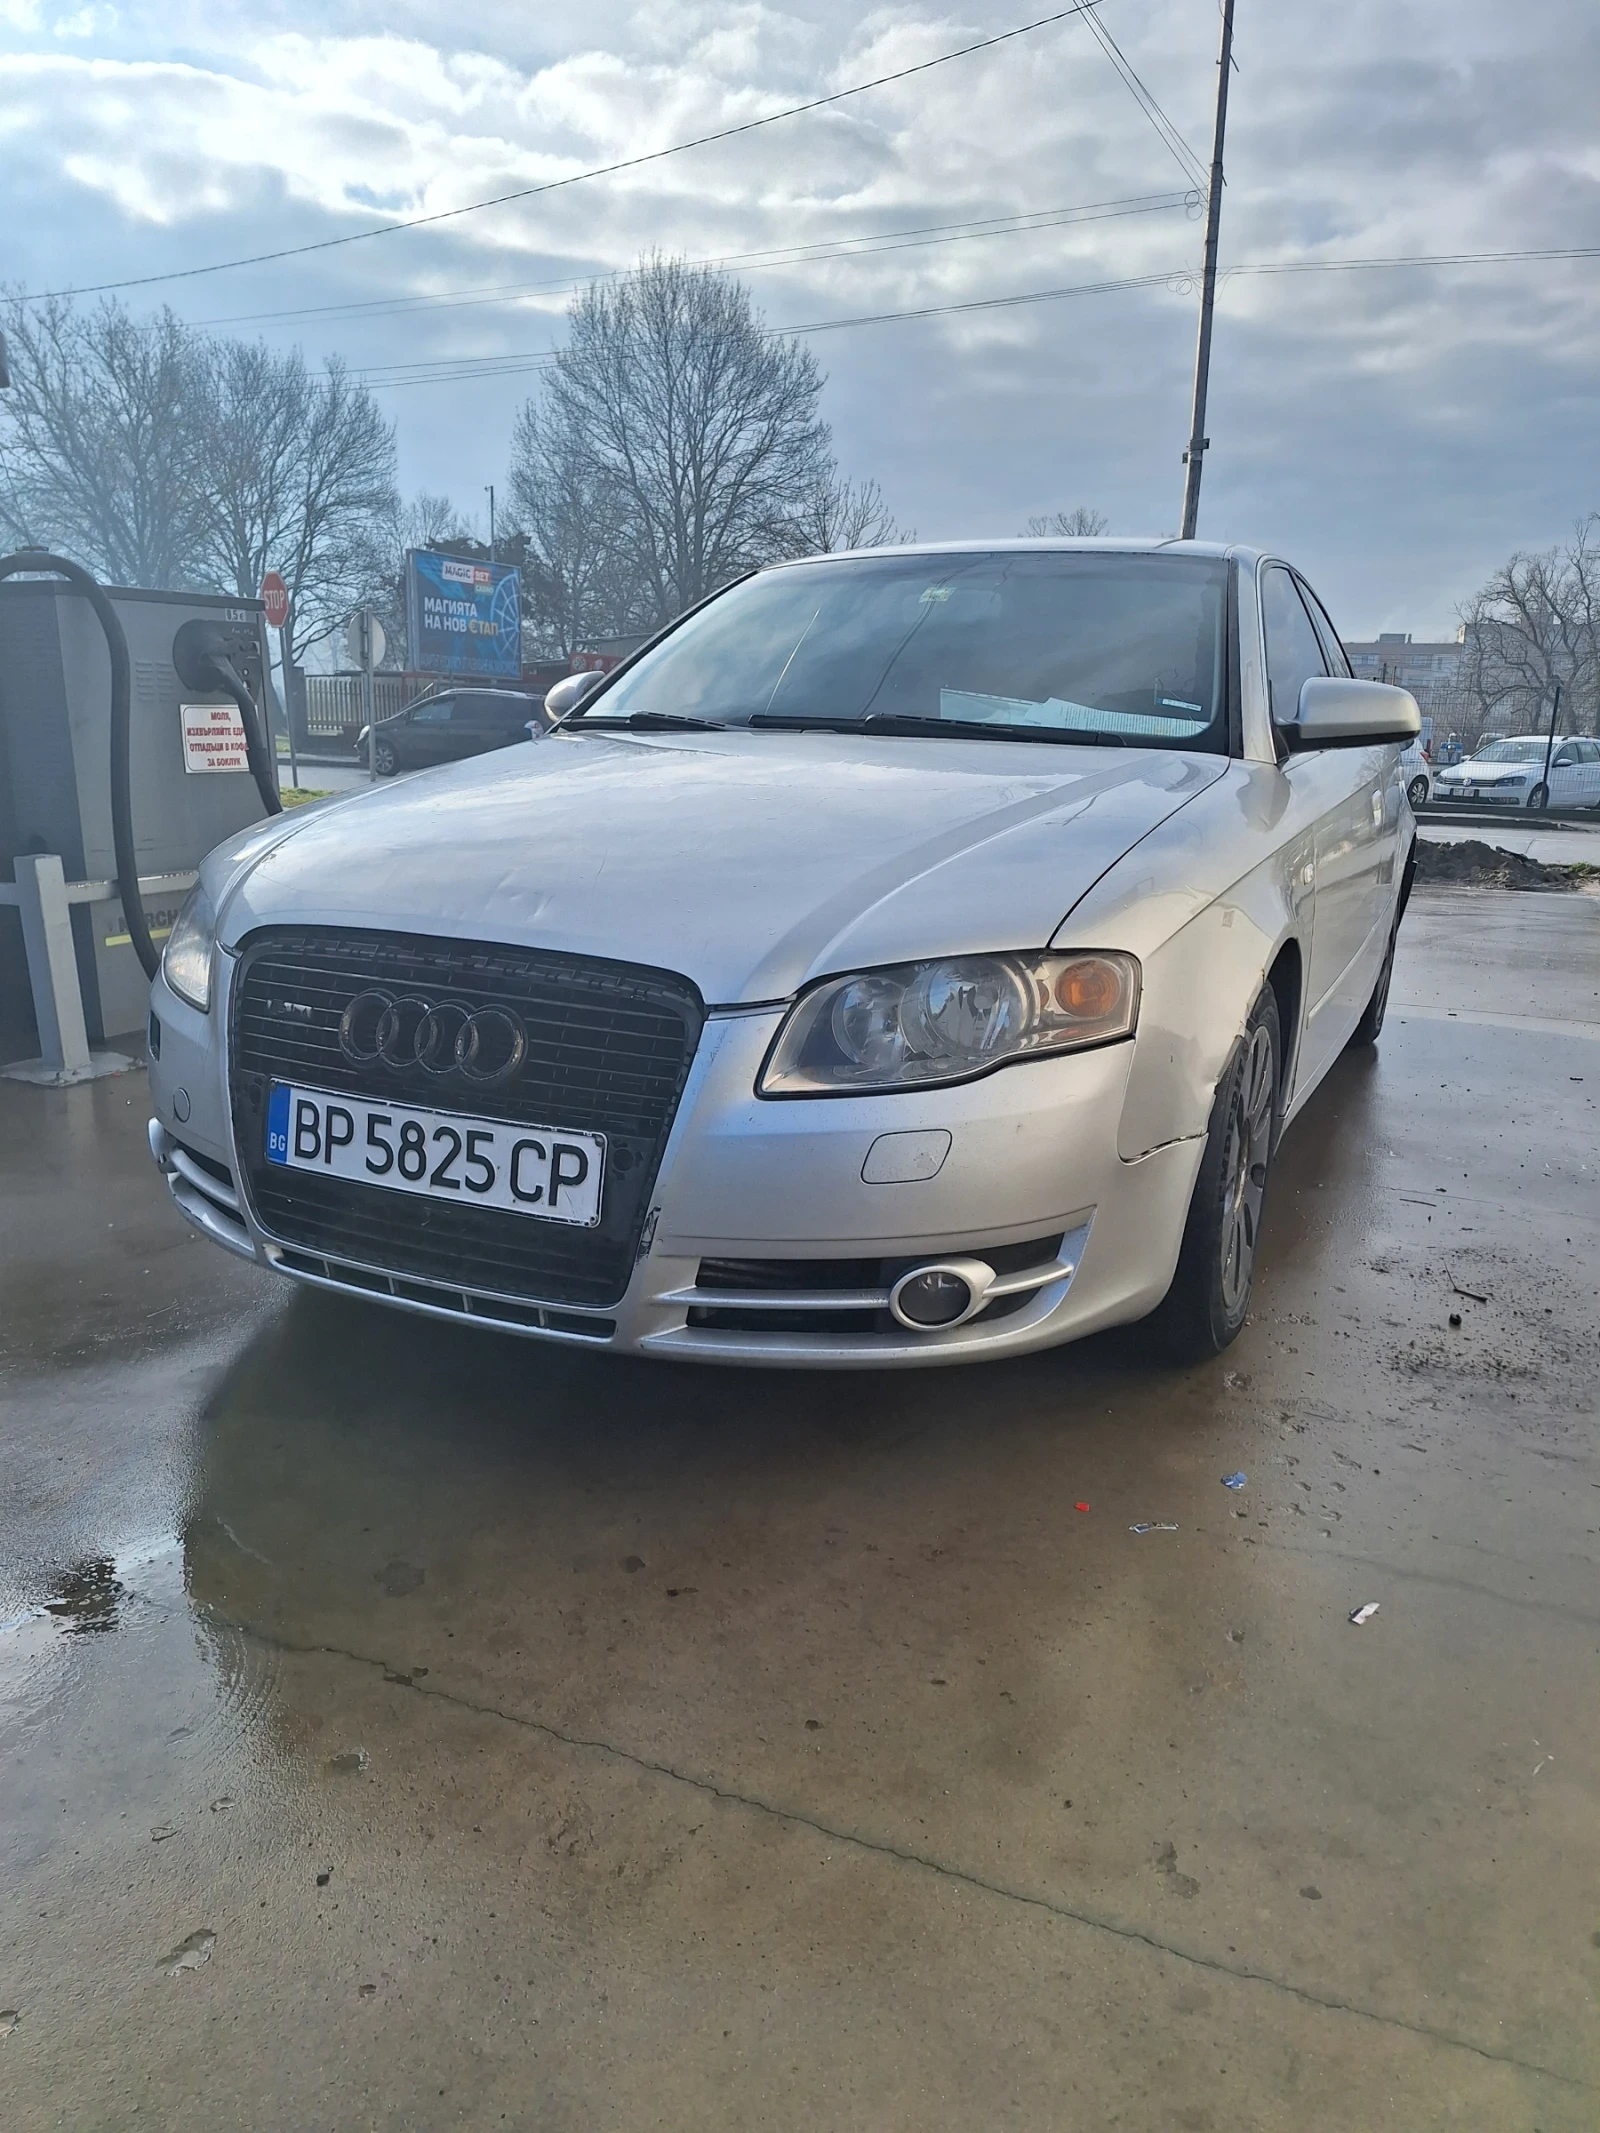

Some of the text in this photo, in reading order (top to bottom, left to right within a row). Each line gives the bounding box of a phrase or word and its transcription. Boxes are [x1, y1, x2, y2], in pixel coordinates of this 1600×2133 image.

[444, 565, 472, 579] MAGIC
[263, 589, 285, 610] STOP
[424, 597, 478, 618] МАГИЯТА
[424, 614, 442, 631] НА
[443, 616, 467, 633] НОВ
[225, 742, 230, 752] В
[207, 757, 242, 767] ЗА БОКЛУК
[269, 1131, 287, 1152] BG
